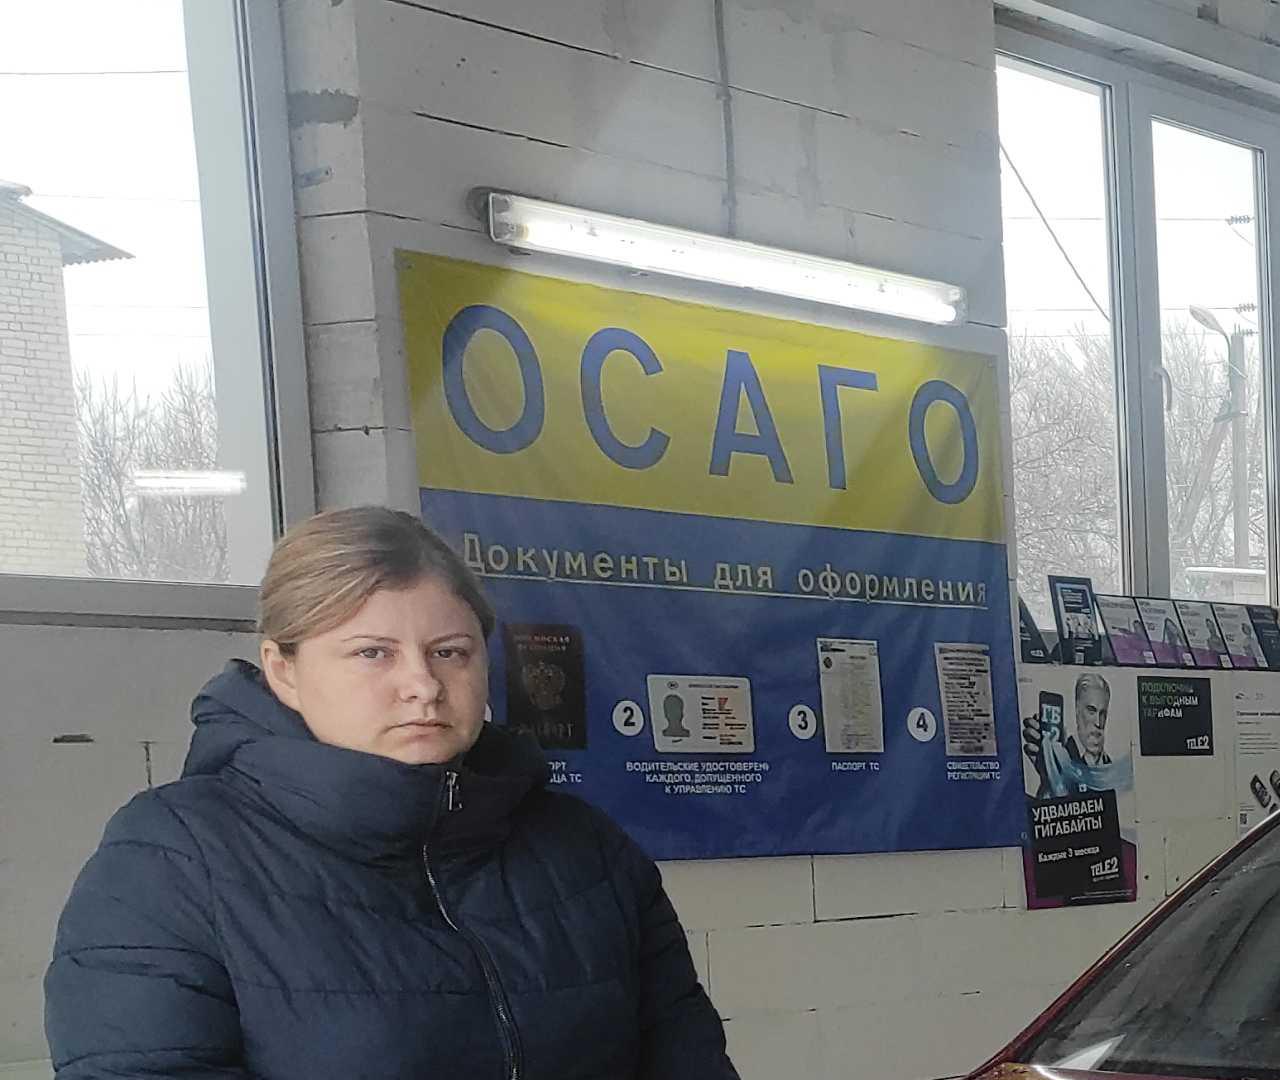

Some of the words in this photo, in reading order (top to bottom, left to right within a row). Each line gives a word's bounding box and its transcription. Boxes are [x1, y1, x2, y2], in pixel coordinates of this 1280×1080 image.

[442, 304, 979, 504] ОСАГО
[463, 533, 688, 583] Документы
[713, 562, 773, 592] для
[799, 564, 988, 604] оформления
[623, 707, 635, 727] 2
[798, 711, 808, 730] 3
[916, 713, 928, 732] 4
[1187, 735, 1210, 749] TELE2
[869, 762, 881, 771] ТС
[735, 785, 746, 793] ТС
[1032, 798, 1103, 822] УДВАИВАЕМ
[1035, 816, 1102, 839] ГИГАБАЙТЫ
[1090, 857, 1118, 876] TELE2
